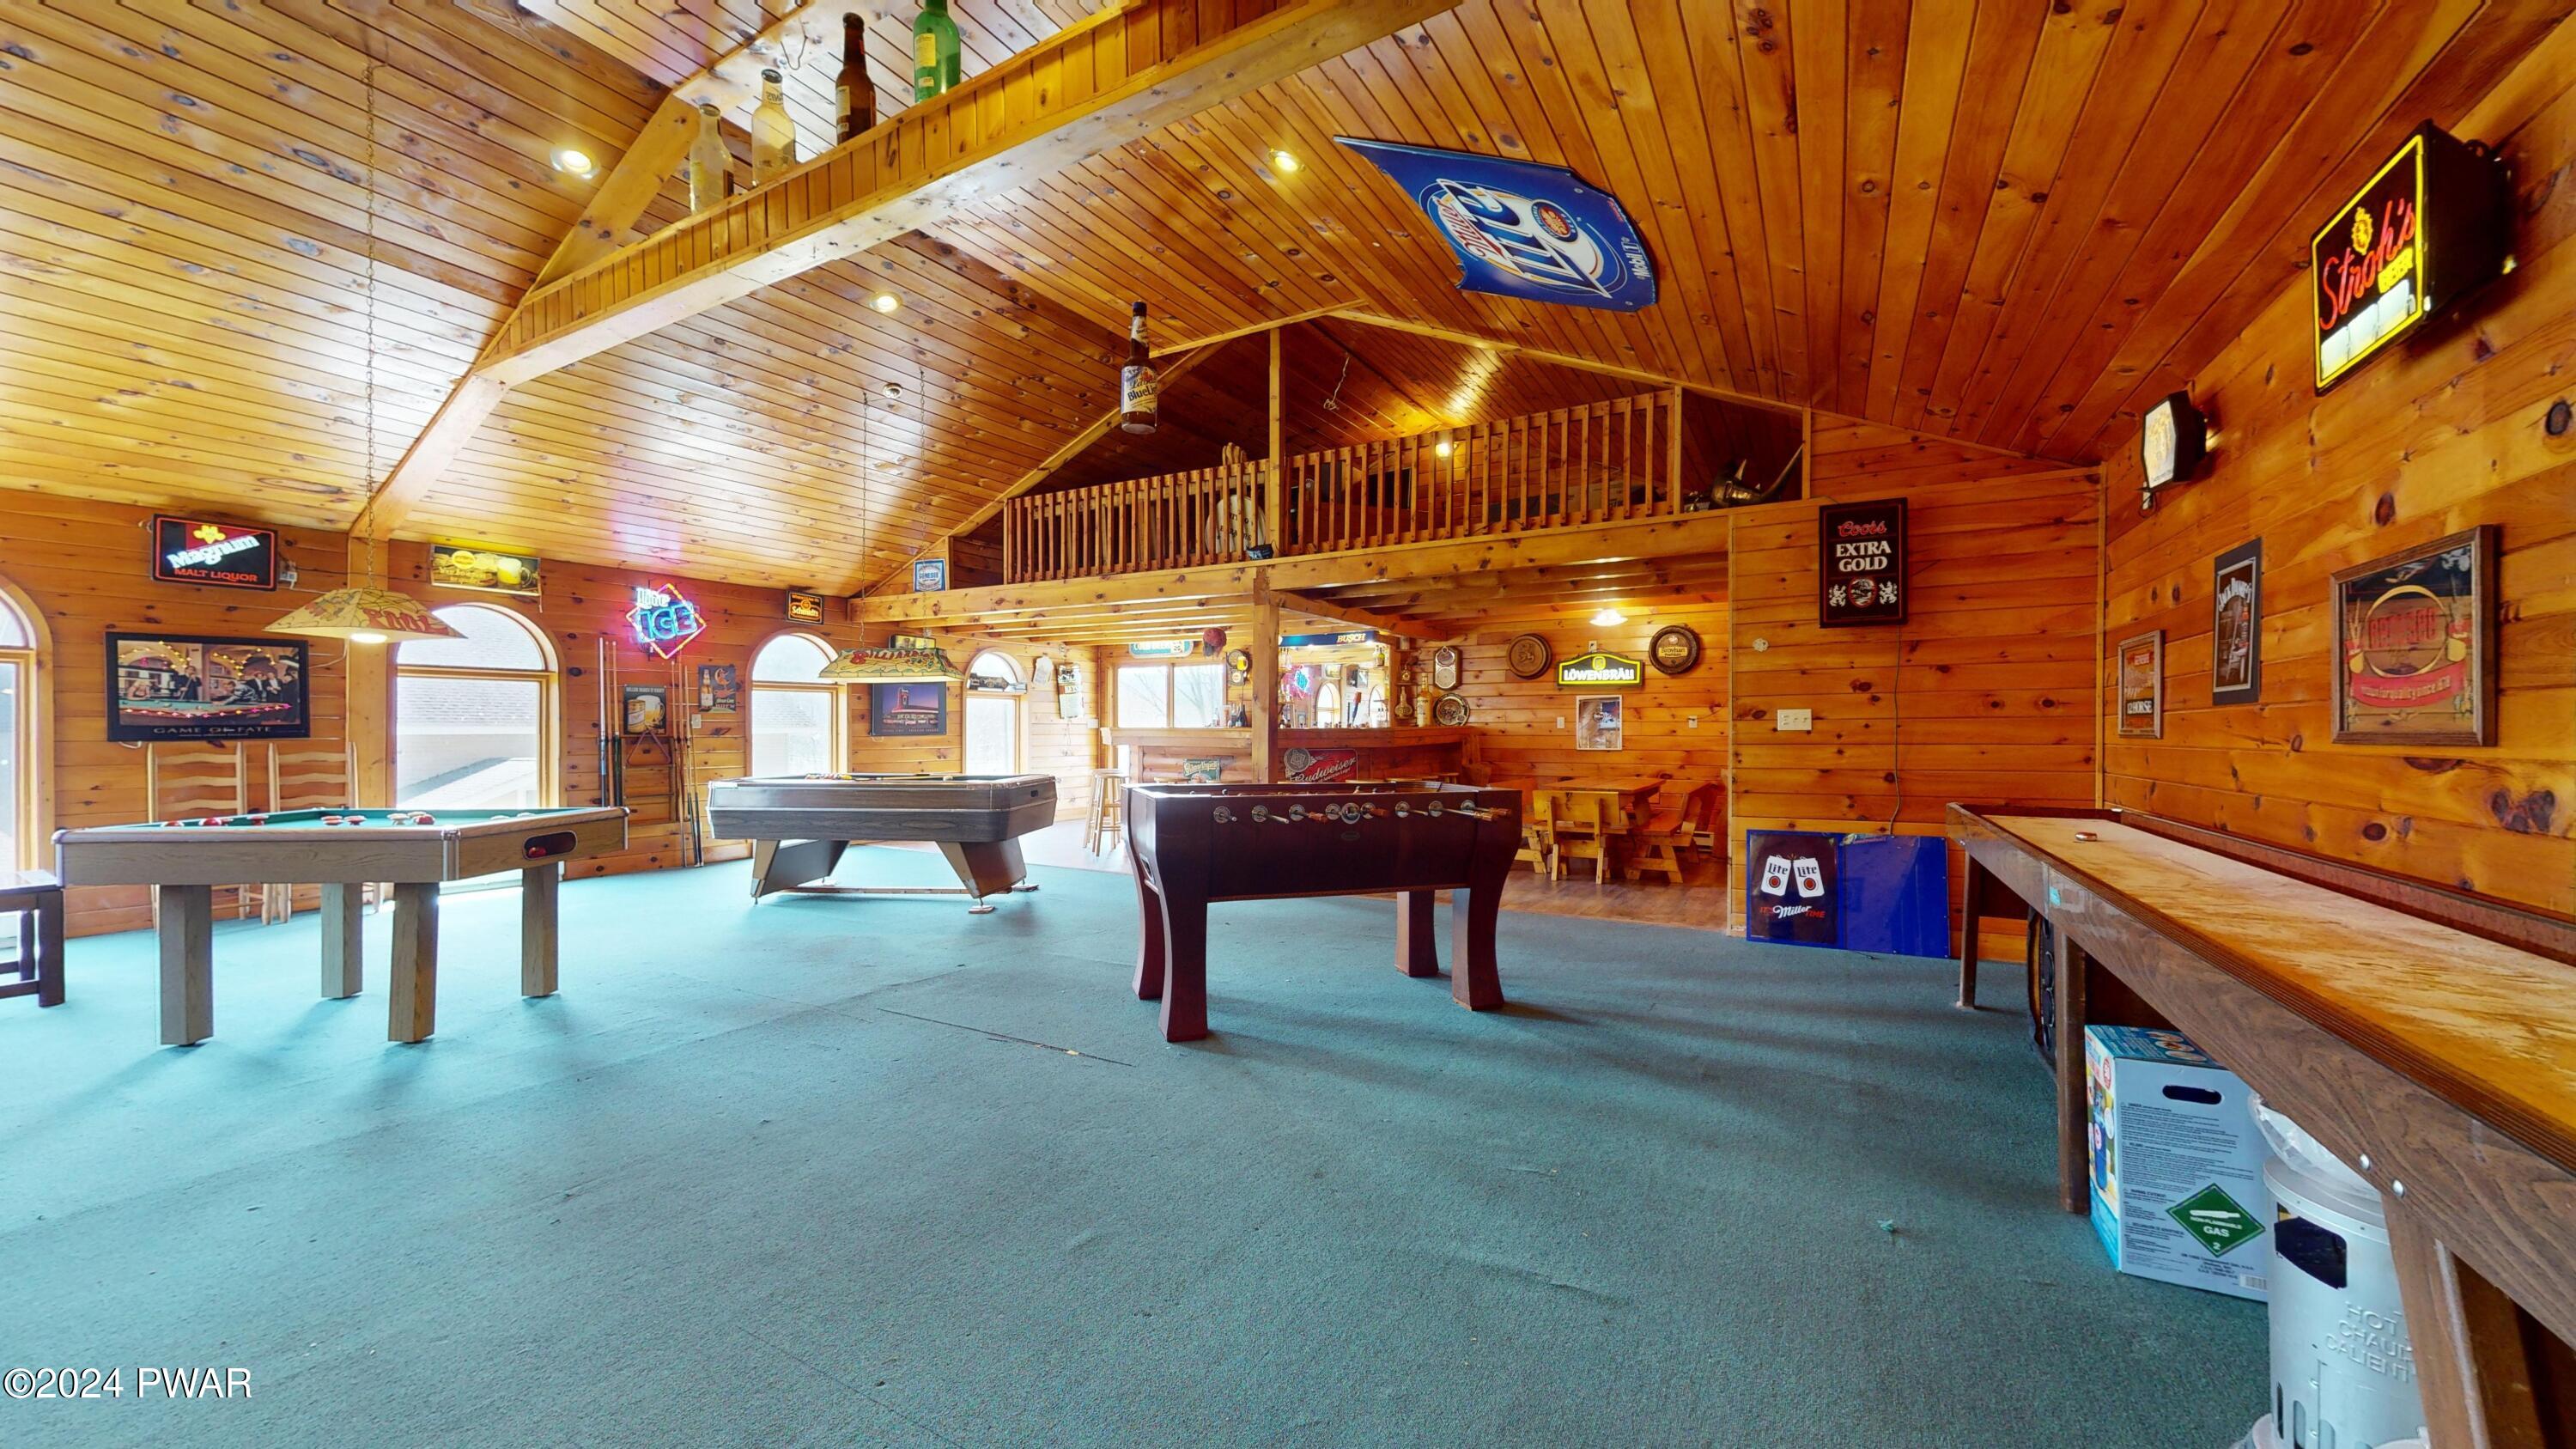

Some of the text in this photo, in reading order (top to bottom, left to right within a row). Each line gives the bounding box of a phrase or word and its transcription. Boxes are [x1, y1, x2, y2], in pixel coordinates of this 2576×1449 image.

[1432, 196, 1507, 260] Miller
[1436, 178, 1613, 299] Lite
[1625, 253, 1650, 278] Mobil
[2319, 198, 2416, 331] Stroh's
[1838, 521, 1887, 537] Coors
[166, 535, 260, 569] Magnum
[1836, 540, 1892, 557] EXTRA
[1838, 556, 1887, 572] GOLD
[174, 568, 258, 581] MALT LIQUOR
[636, 601, 698, 642] ICE
[1337, 633, 1367, 643] BUSCH
[1564, 667, 1634, 681] LÖWENBRÄU
[1767, 862, 1789, 874] Lite
[1797, 865, 1817, 877] Lite
[1772, 904, 1813, 919] Miller
[2202, 1226, 2230, 1238] GAS
[2213, 1242, 2221, 1251] 2
[2344, 1300, 2397, 1336] HOT
[2326, 1333, 2409, 1384] CALIENT
